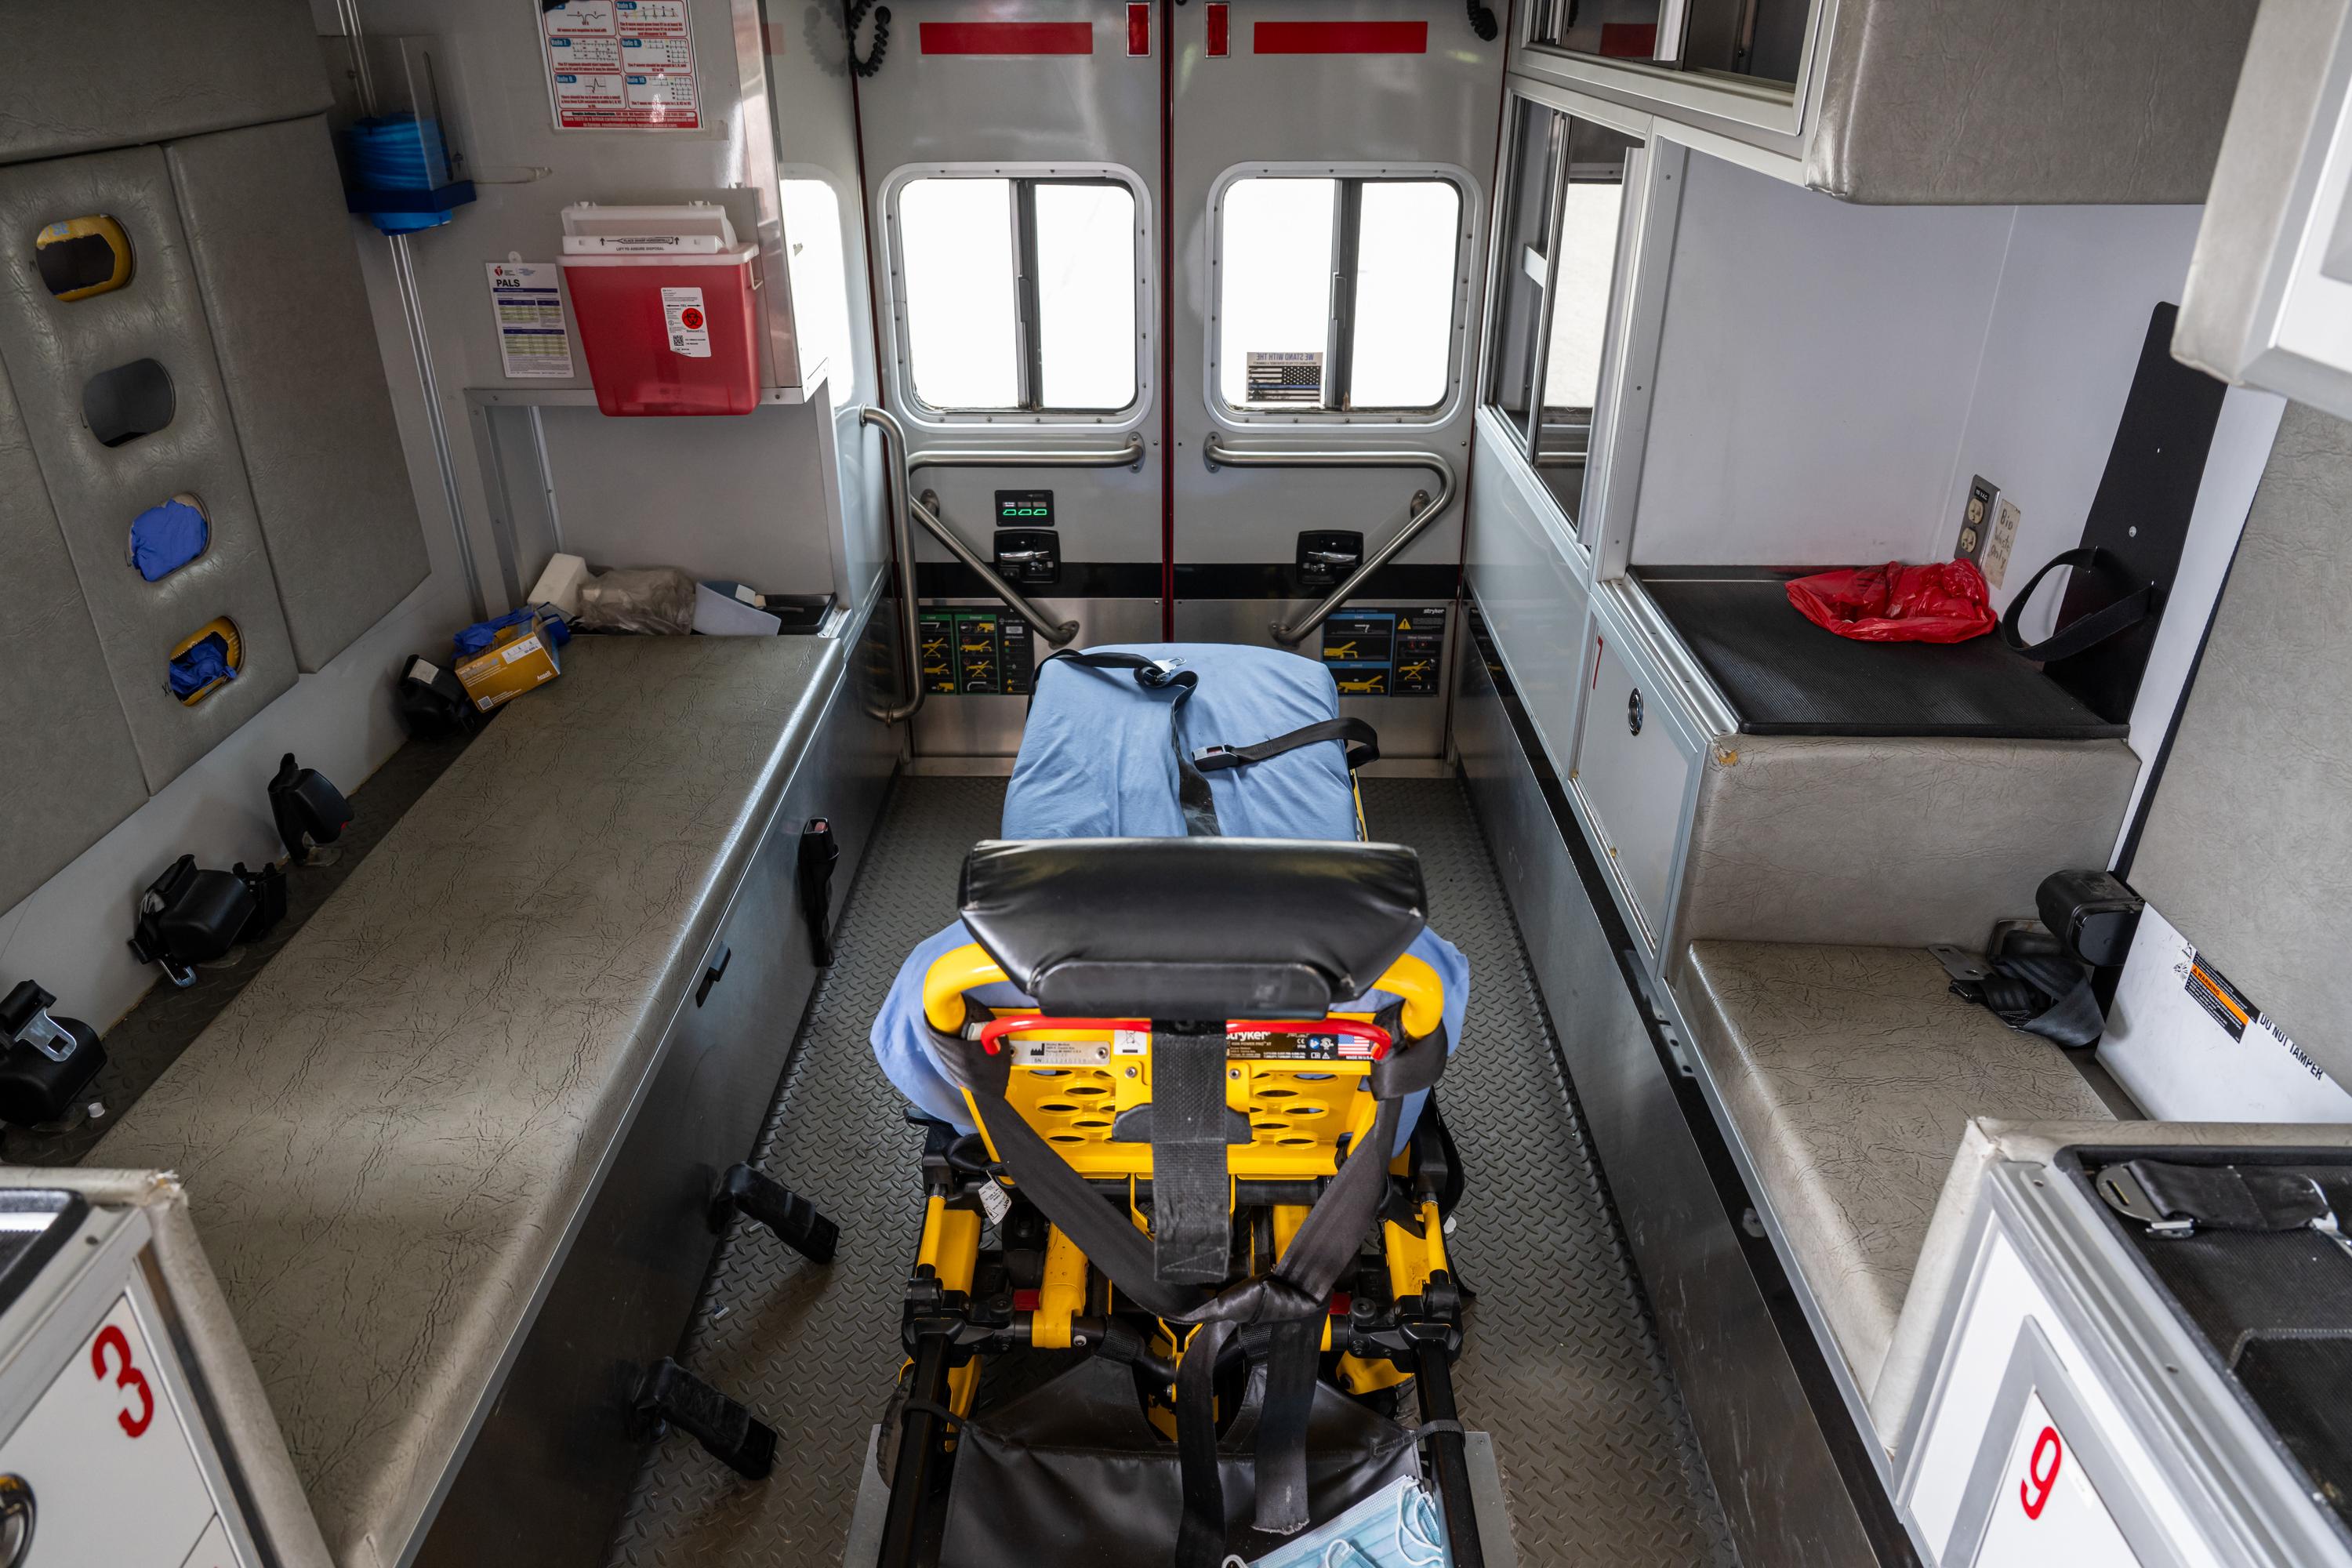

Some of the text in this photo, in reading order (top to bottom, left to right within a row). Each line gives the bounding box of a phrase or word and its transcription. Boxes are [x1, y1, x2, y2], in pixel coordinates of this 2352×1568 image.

[2000, 508, 2013, 530] Bio
[1989, 544, 2006, 569] Only
[2197, 972, 2220, 996] WARNING
[92, 1325, 154, 1438] 3
[2020, 1426, 2062, 1520] 9
